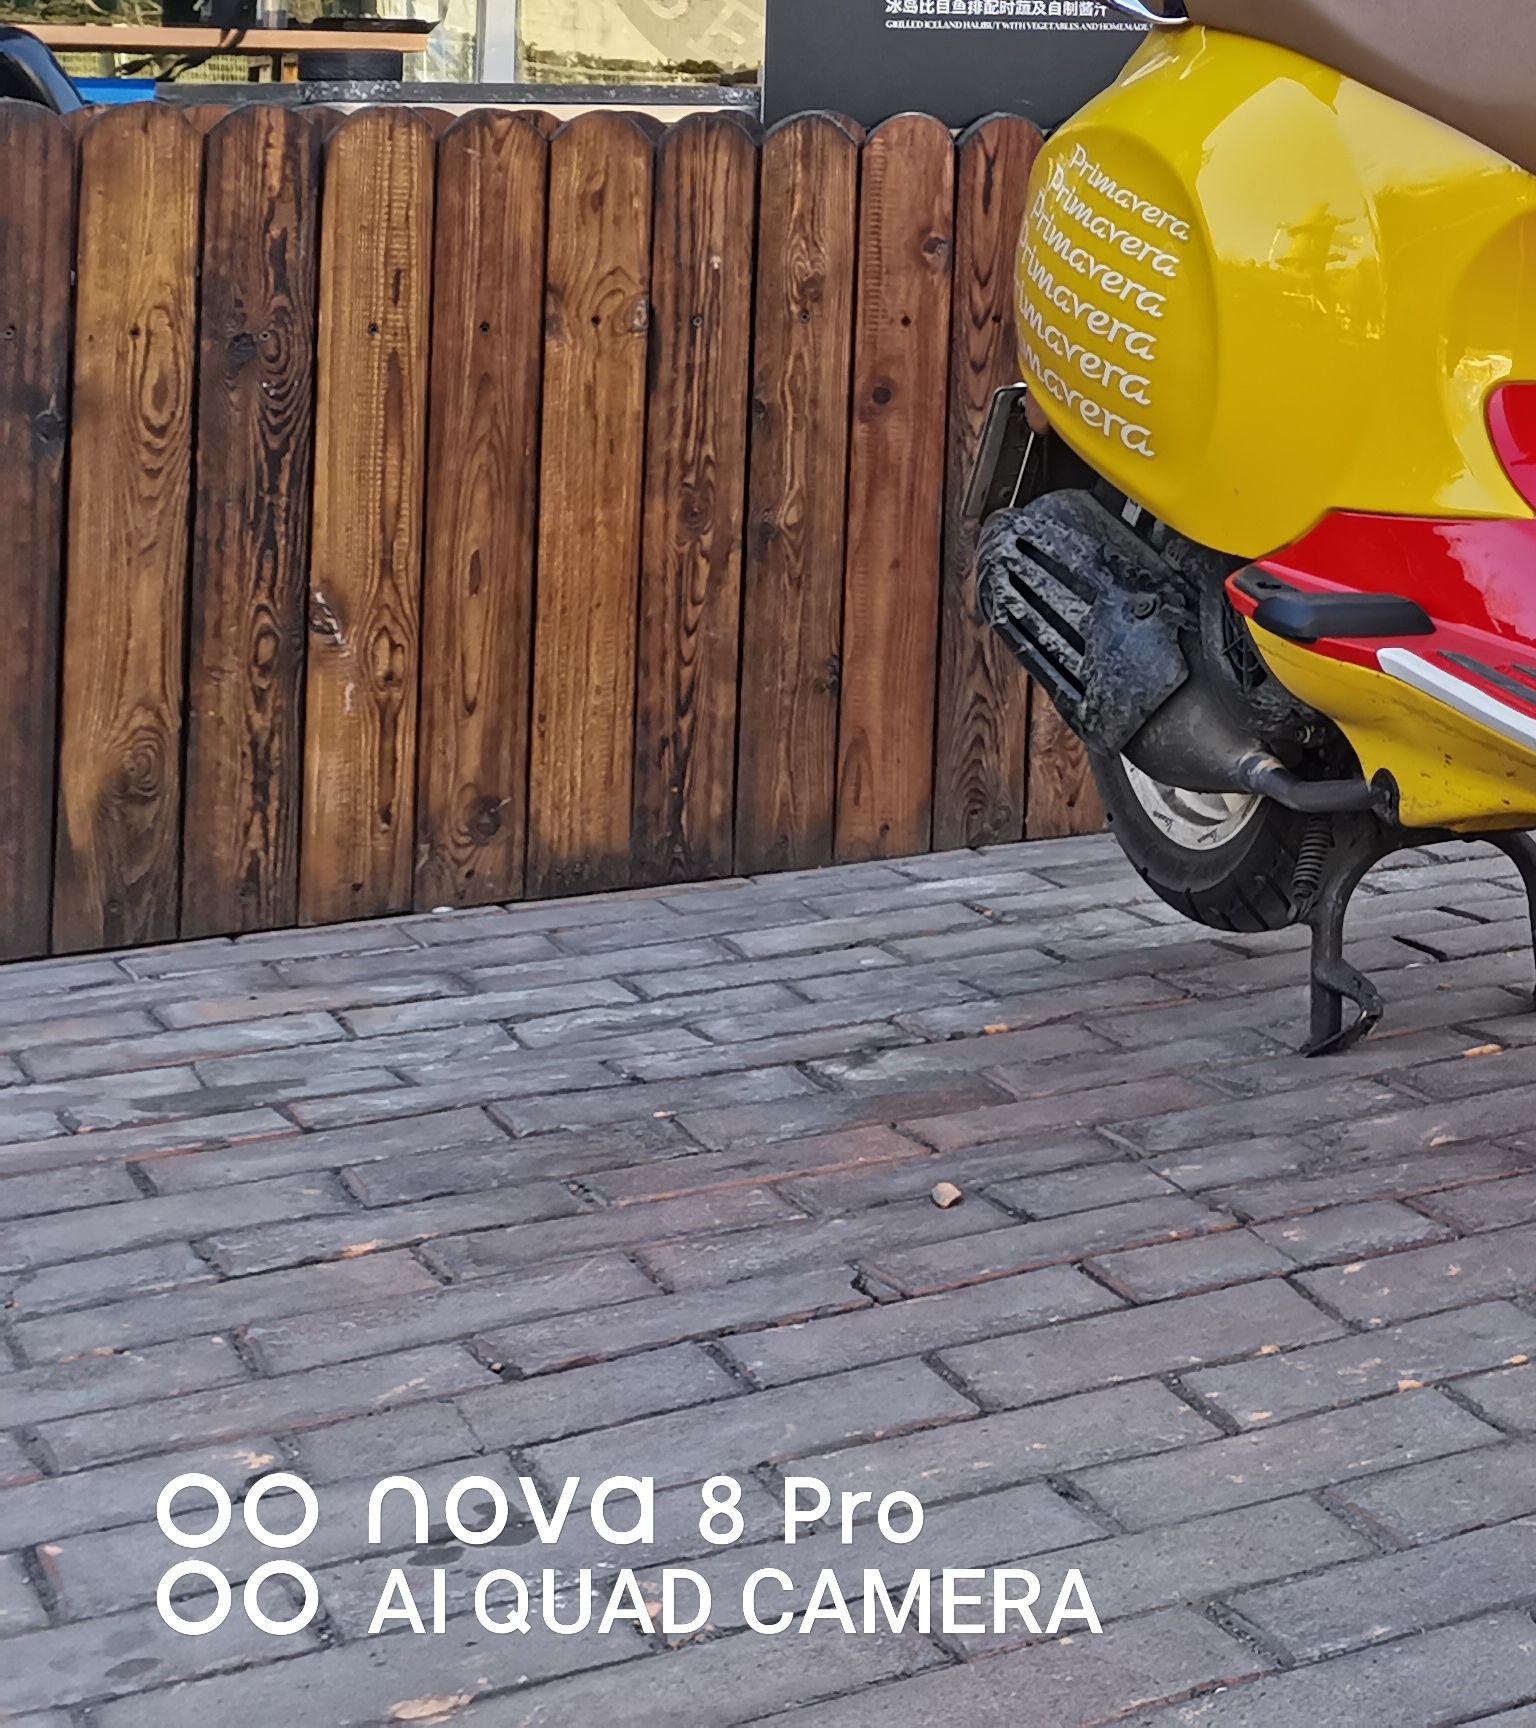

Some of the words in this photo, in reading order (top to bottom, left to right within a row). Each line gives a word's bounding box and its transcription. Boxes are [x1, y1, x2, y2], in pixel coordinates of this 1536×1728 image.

[1049, 161, 1180, 278] Primavera
[1070, 143, 1191, 241] Primavera
[1031, 189, 1167, 319] Primavera
